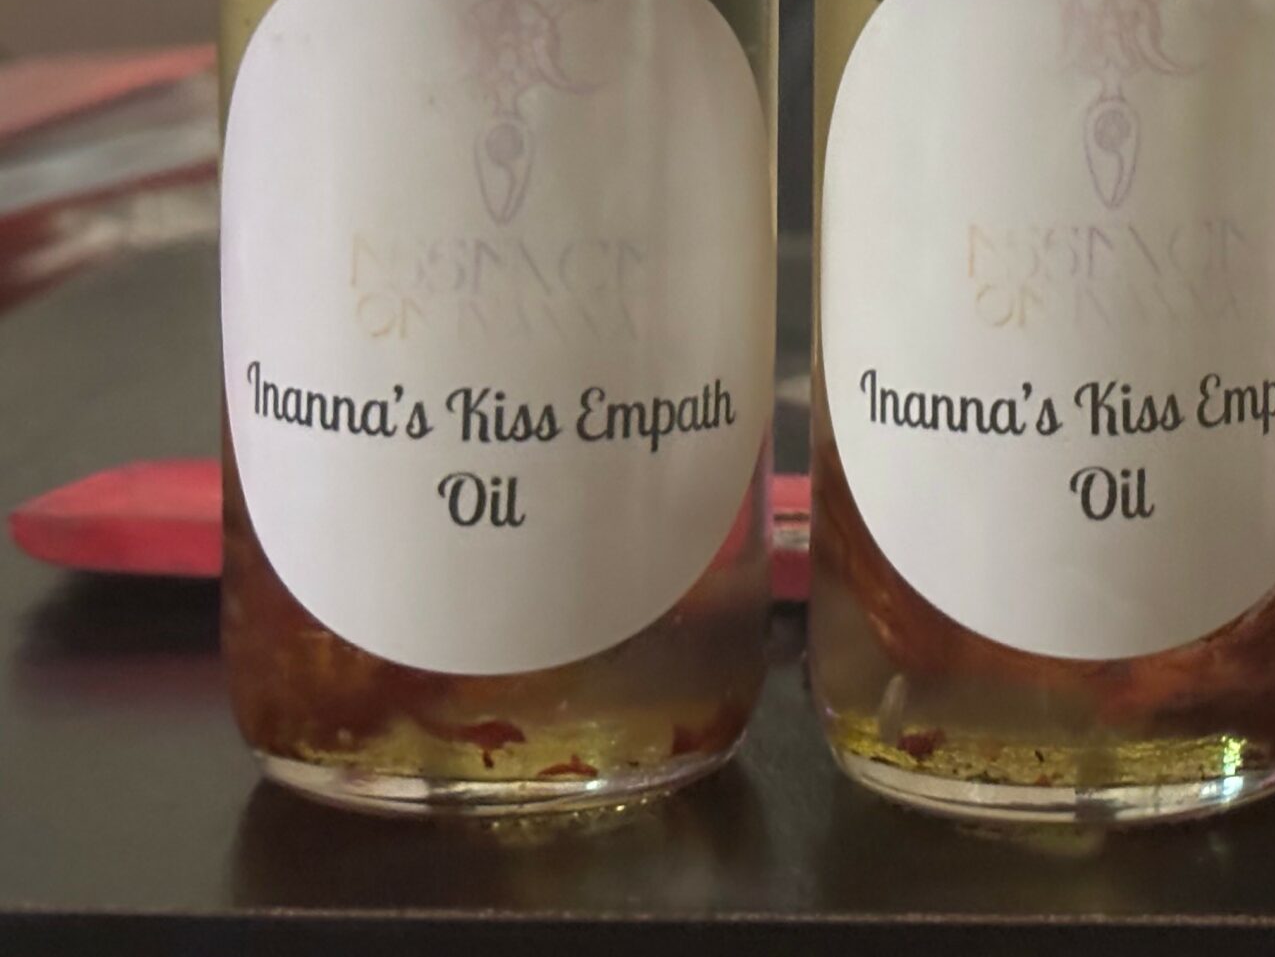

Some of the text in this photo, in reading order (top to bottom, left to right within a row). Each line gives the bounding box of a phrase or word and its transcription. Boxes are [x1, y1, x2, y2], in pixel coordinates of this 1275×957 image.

[246, 360, 736, 454] Inanna's Kiss Empath
[859, 368, 1064, 437] Inanna's
[1073, 380, 1185, 437] Kiss
[436, 471, 527, 528] Oil
[1069, 466, 1155, 522] Oil
